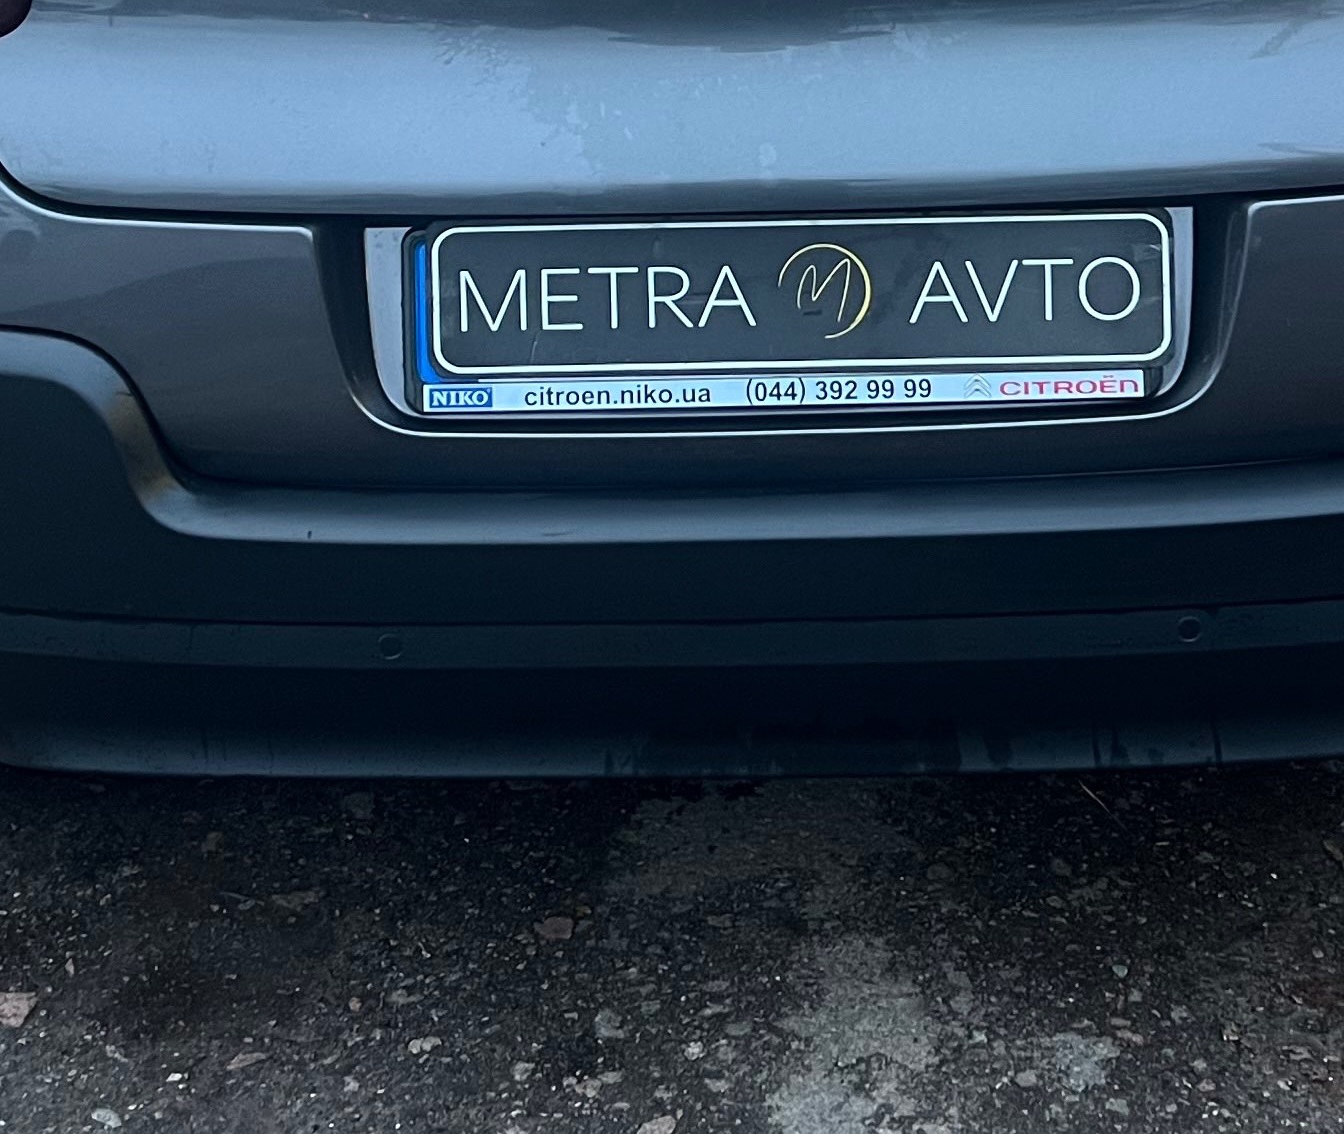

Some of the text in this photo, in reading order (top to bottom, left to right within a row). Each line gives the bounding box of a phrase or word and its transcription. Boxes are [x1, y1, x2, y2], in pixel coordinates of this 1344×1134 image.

[459, 265, 757, 333] METRA
[908, 256, 1141, 324] AVTO
[431, 388, 490, 407] NIKO
[524, 383, 712, 407] citroen.niko.ua
[745, 377, 932, 406] (044) 392 99 99
